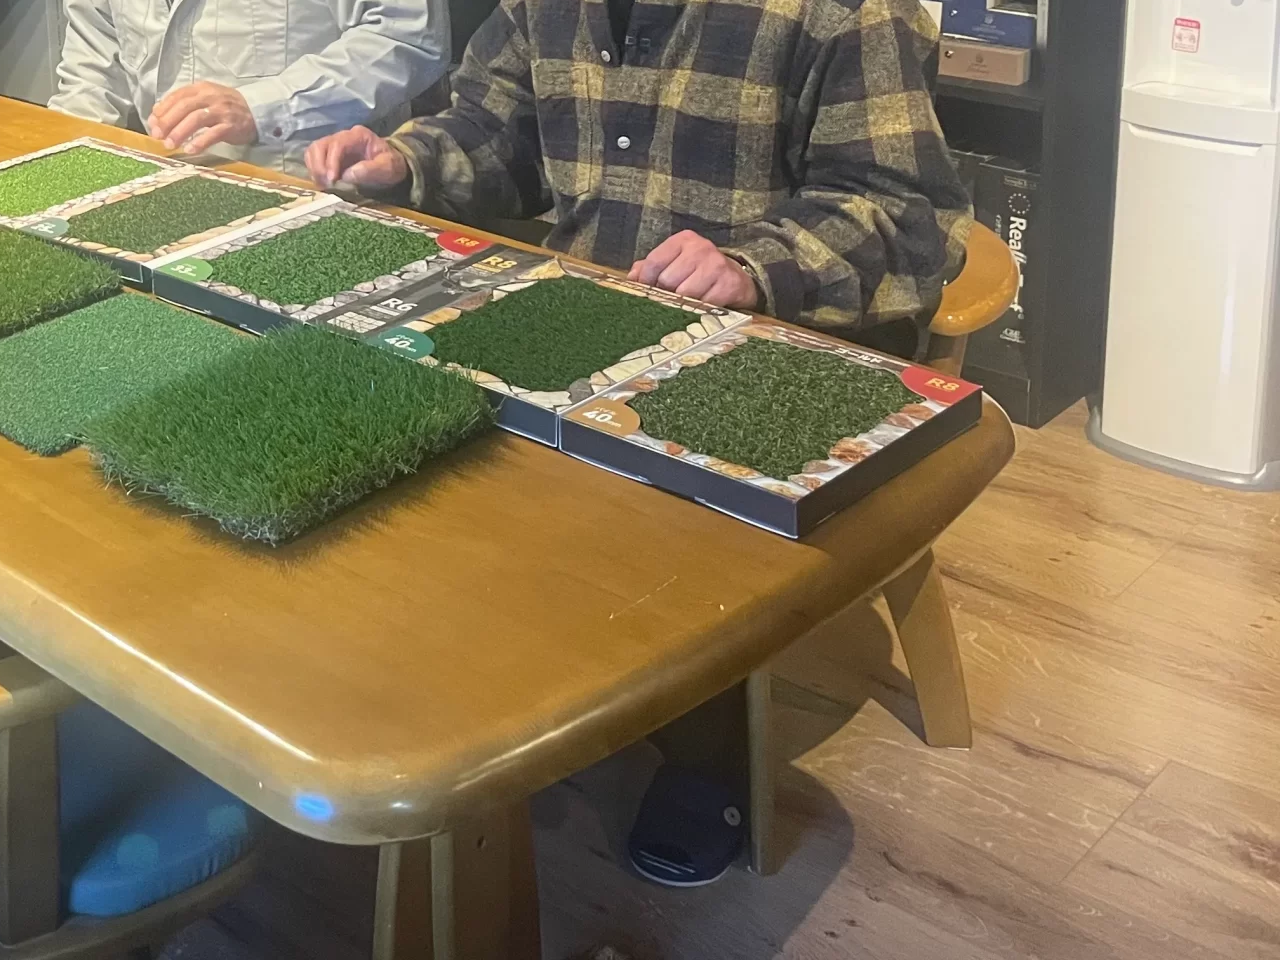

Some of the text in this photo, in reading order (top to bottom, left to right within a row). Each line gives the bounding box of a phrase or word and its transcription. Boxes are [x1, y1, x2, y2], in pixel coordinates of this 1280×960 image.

[454, 236, 480, 247] R8
[482, 255, 518, 269] R8
[380, 297, 418, 311] R6
[834, 347, 884, 364] ゴールド
[924, 377, 960, 391] R8
